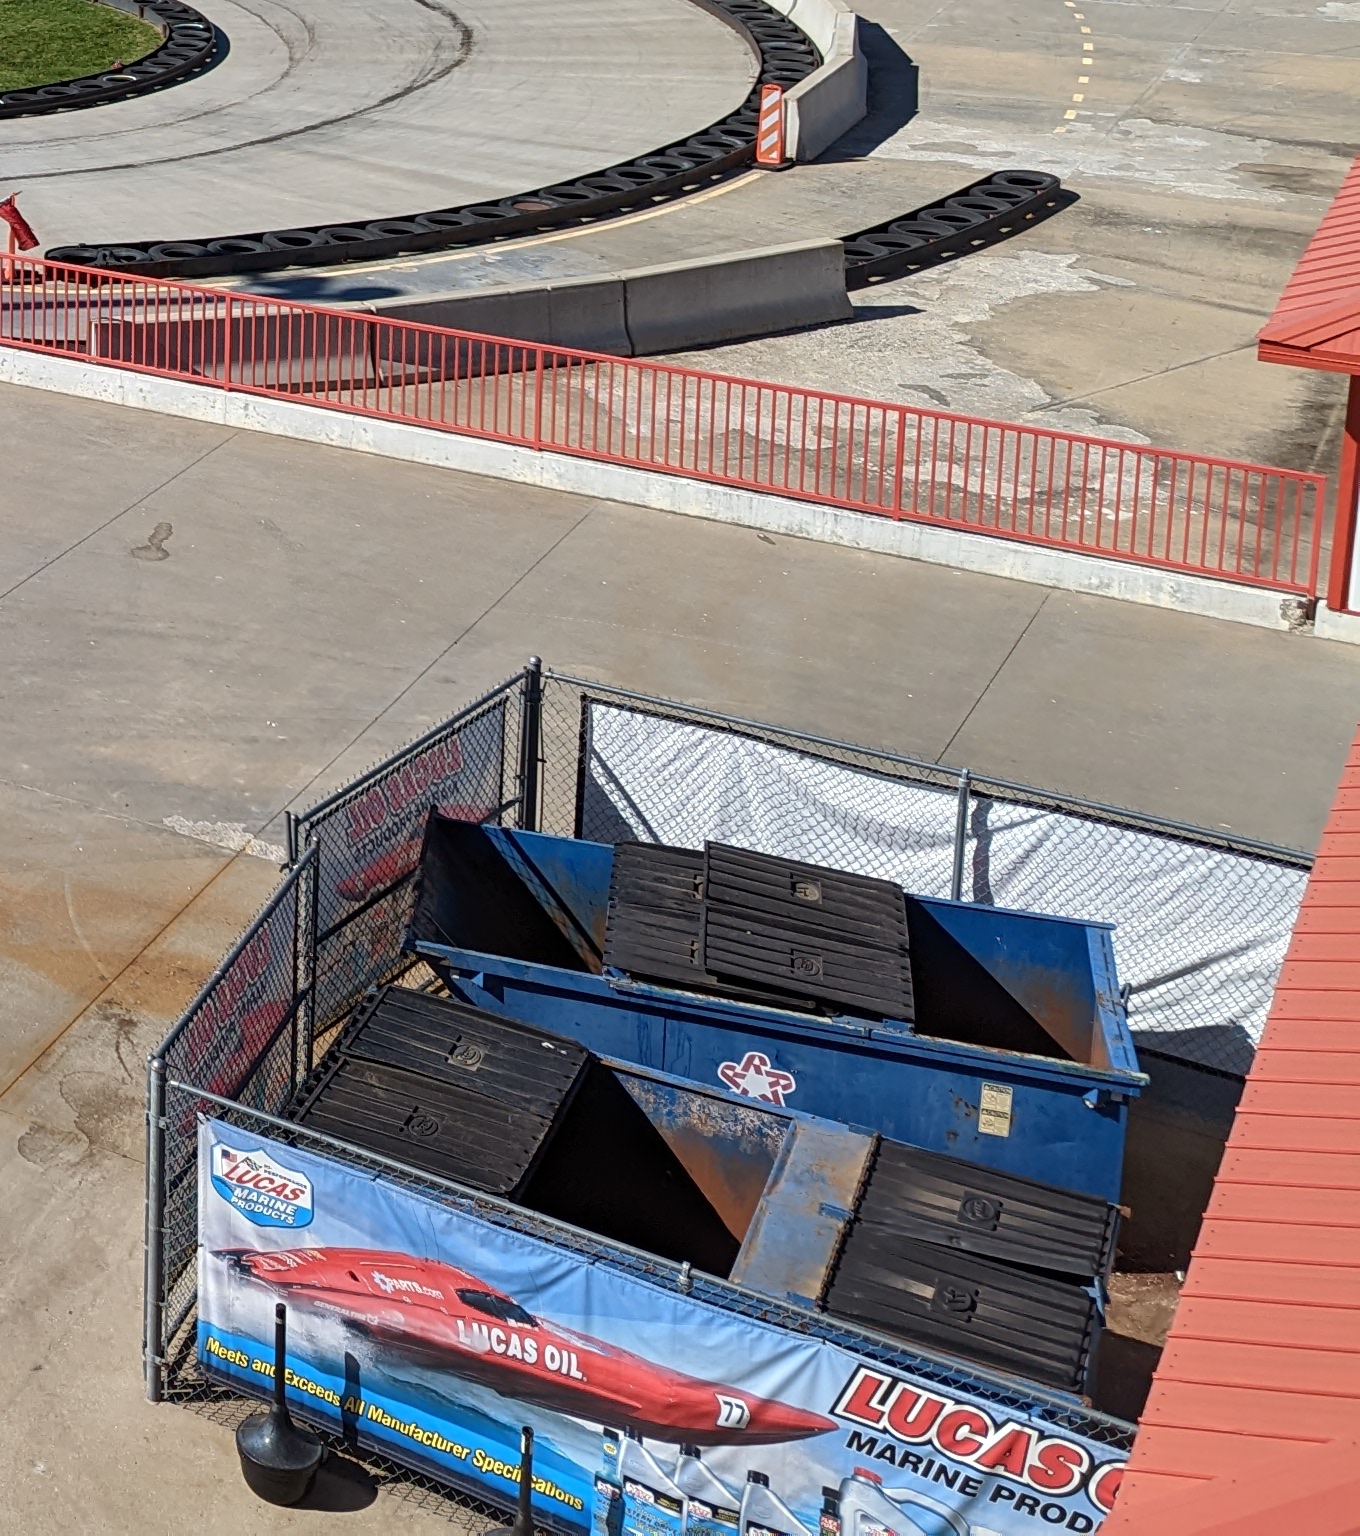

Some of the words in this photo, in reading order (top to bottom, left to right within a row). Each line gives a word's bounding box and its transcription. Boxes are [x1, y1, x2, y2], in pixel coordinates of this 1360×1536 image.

[223, 1165, 306, 1201] LUCAS
[233, 1187, 298, 1216] MARINE
[231, 1197, 295, 1225] PRODUCTS
[457, 1319, 538, 1364] LUCAS
[206, 1337, 249, 1368] Meets
[285, 1369, 341, 1407] Exceeds
[344, 1396, 365, 1416] All
[368, 1404, 471, 1461] Manufacturer
[473, 1449, 583, 1510] Specications
[722, 1400, 746, 1425] 77
[838, 1369, 1089, 1494] LUCAS
[846, 1430, 983, 1498] MARINE
[988, 1482, 1103, 1535] PROD
